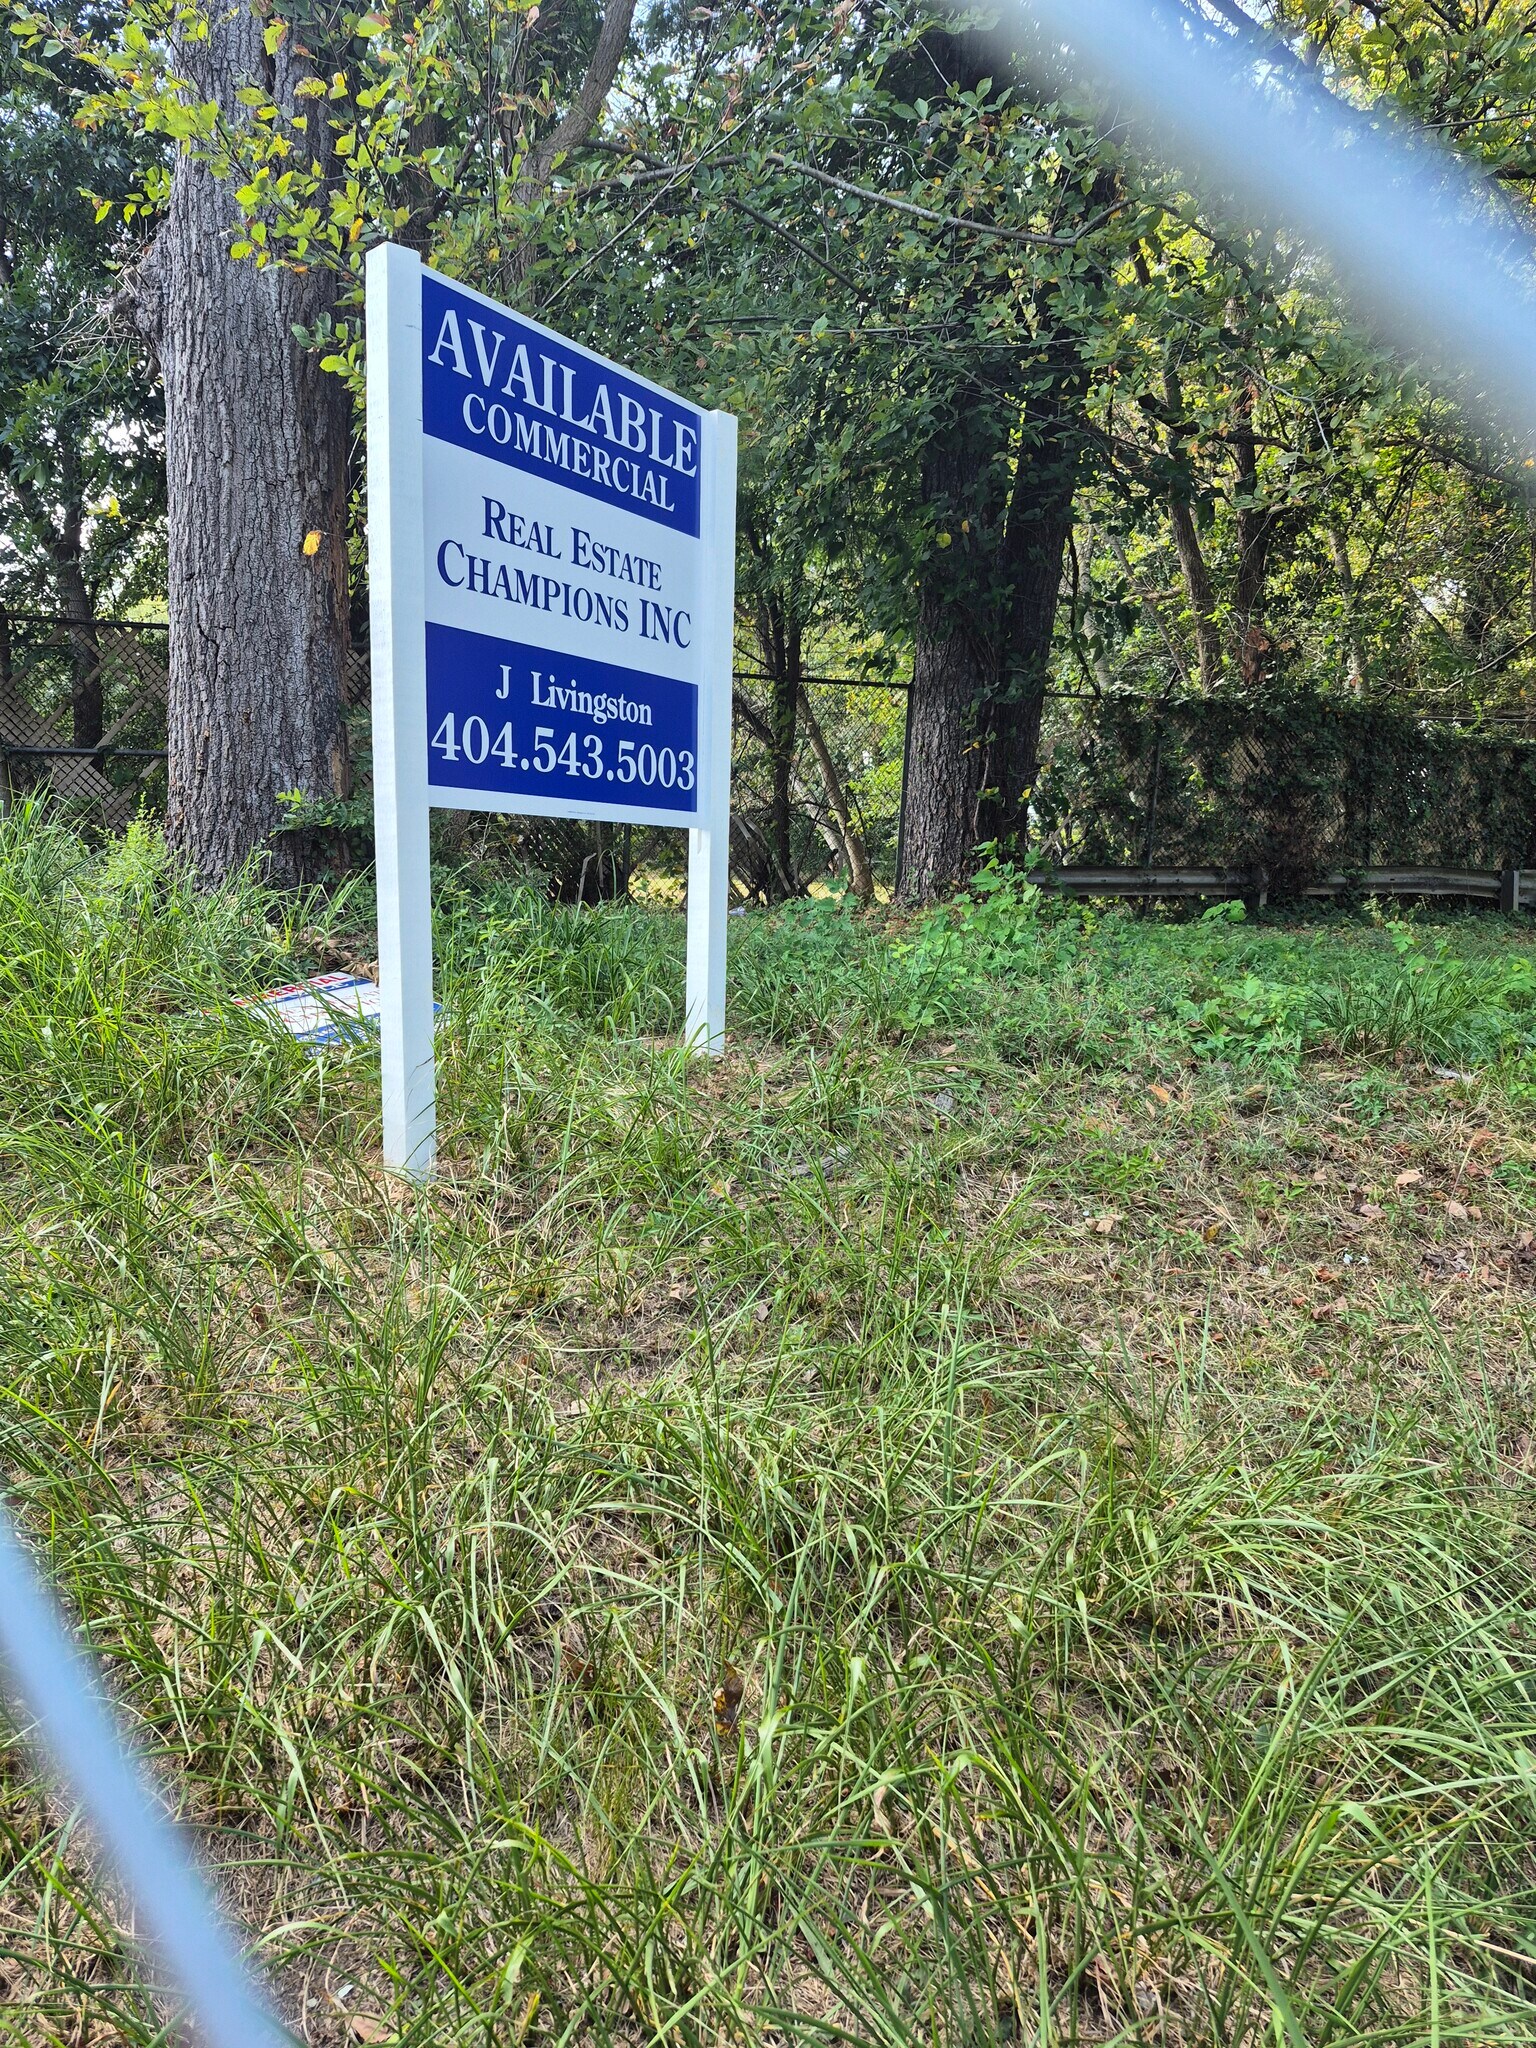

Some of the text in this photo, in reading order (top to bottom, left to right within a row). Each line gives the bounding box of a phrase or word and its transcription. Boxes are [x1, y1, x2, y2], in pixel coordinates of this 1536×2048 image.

[427, 309, 698, 478] AVAILABLE
[462, 393, 675, 512] COMMERCIAL
[437, 539, 692, 650] CHAMPIONS INC
[481, 495, 663, 592] REAL ESTATE
[495, 664, 653, 726] J Livingston
[431, 712, 696, 792] 404.543.5003
